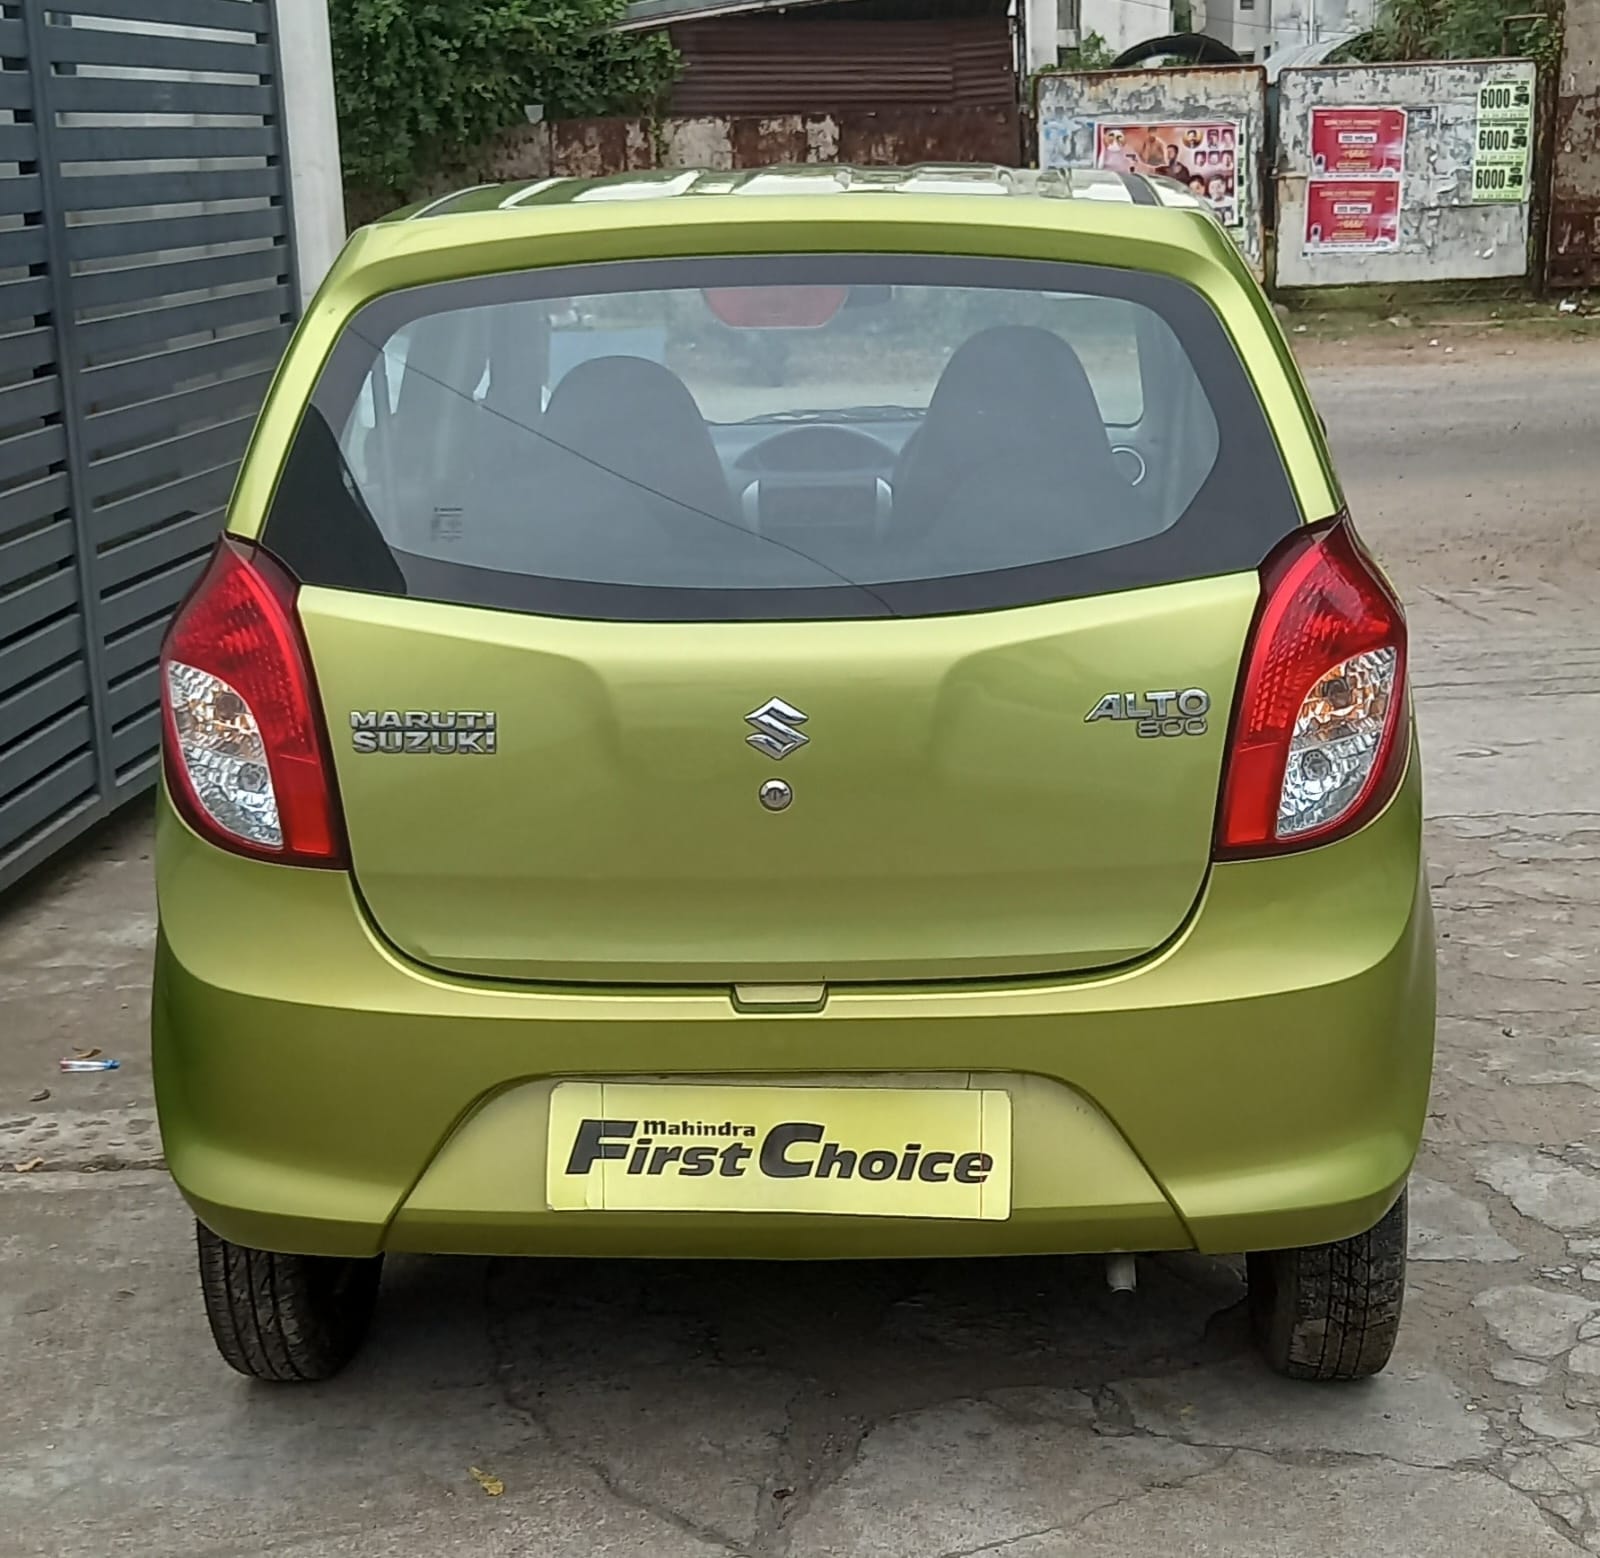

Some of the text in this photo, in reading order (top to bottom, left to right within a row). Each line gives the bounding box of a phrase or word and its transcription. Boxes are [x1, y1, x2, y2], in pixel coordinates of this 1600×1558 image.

[1480, 88, 1510, 109] 6000
[1479, 130, 1509, 151] 6000
[1475, 169, 1505, 189] 6000
[1084, 688, 1209, 722] ALTO
[350, 710, 496, 729] MARUTI
[1137, 717, 1208, 738] 800
[352, 730, 496, 754] SUZUKI
[642, 1120, 756, 1137] Mahindra
[566, 1119, 994, 1184] First Choice
